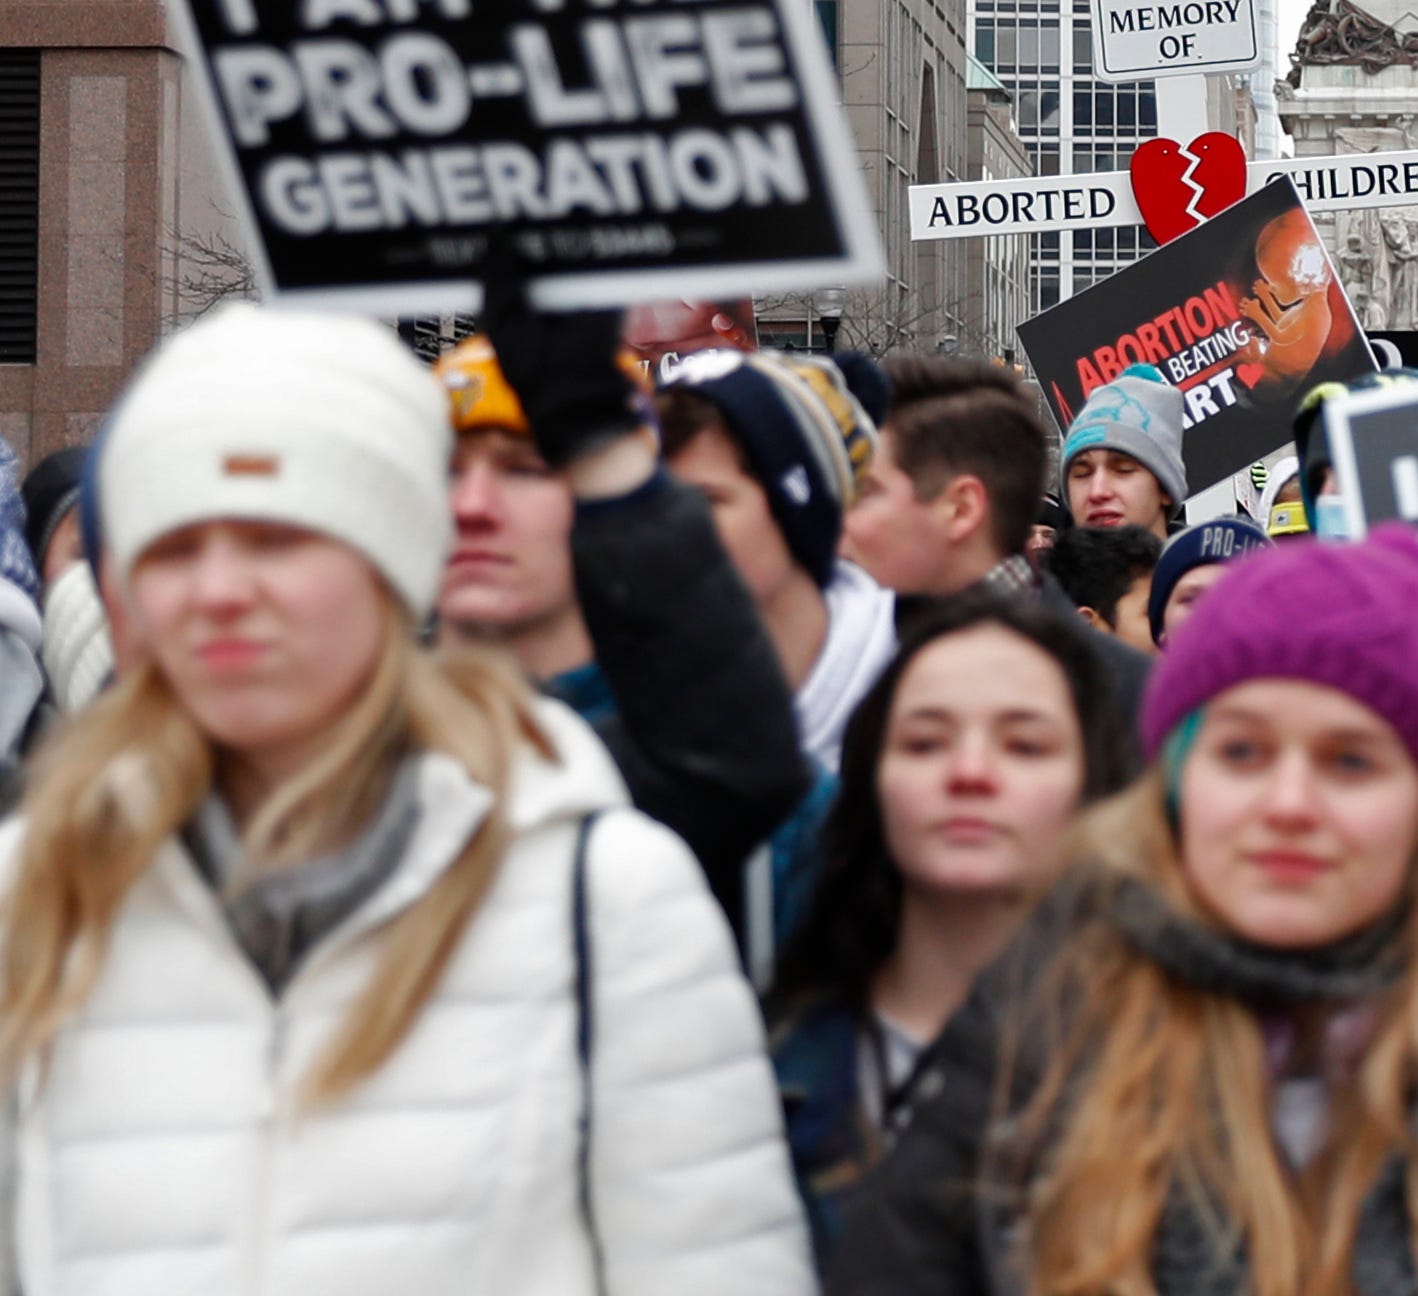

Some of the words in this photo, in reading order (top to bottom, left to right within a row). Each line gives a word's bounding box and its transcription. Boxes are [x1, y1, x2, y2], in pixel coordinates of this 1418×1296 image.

[1109, 0, 1242, 34] MEMORY
[1159, 33, 1197, 59] OF
[215, 7, 800, 148] PRO-LIFE
[258, 123, 810, 236] GENERATION
[928, 187, 1117, 228] ABORTED
[1076, 281, 1242, 401] ABORTION
[1168, 320, 1251, 384] BEATING
